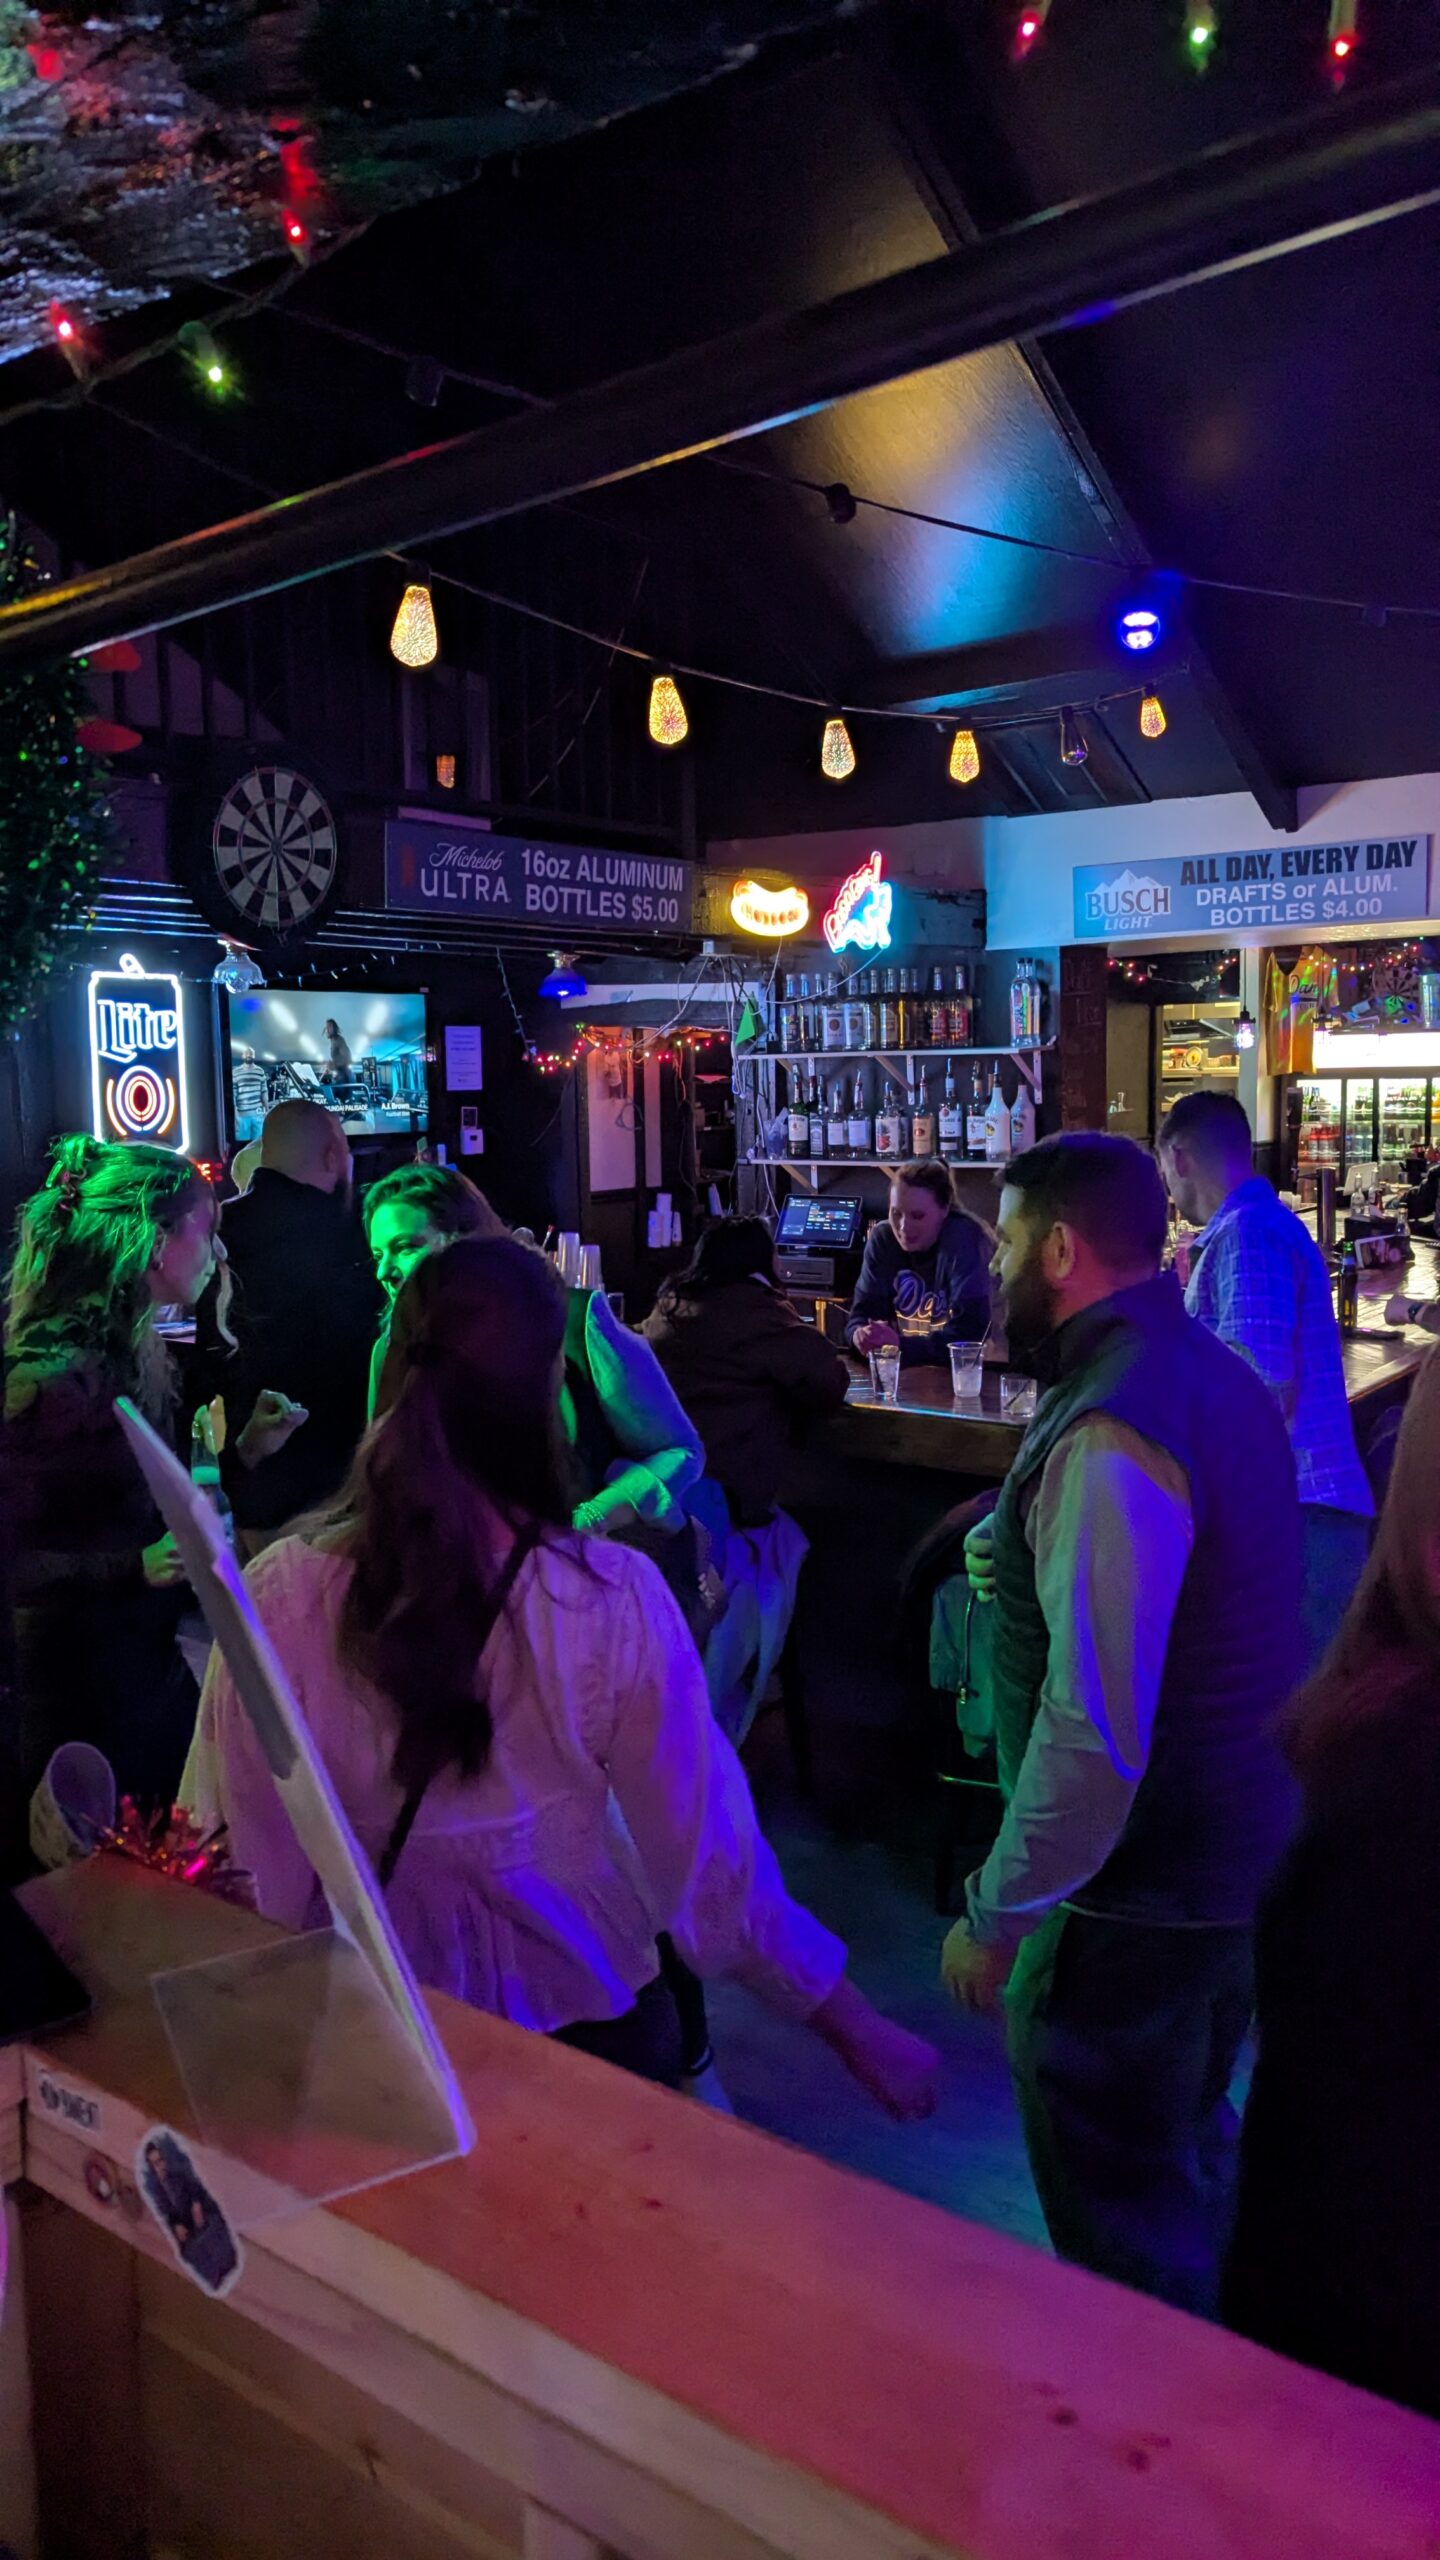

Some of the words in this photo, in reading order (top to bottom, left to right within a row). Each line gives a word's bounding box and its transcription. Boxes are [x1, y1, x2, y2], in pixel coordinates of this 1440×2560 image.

[429, 842, 503, 871] Michelob
[521, 849, 570, 880] 16oz
[576, 855, 684, 892] ALUMINUM
[1181, 860, 1220, 886] ALL
[1226, 853, 1274, 882] DAY,
[1281, 846, 1358, 877] EVERY
[1366, 840, 1417, 870] DAY
[420, 868, 510, 903] ULTRA
[1086, 886, 1170, 919] BUSCH
[1196, 883, 1286, 907] DRAFTS
[1293, 883, 1316, 898] or
[1323, 874, 1398, 896] ALUM.
[525, 884, 625, 918] BOTTLES
[631, 896, 679, 923] $5.00
[1210, 902, 1315, 927] BOTTLES
[1322, 897, 1382, 921] $4.00
[1104, 915, 1152, 931] LIGHT
[97, 1000, 176, 1063] Lite
